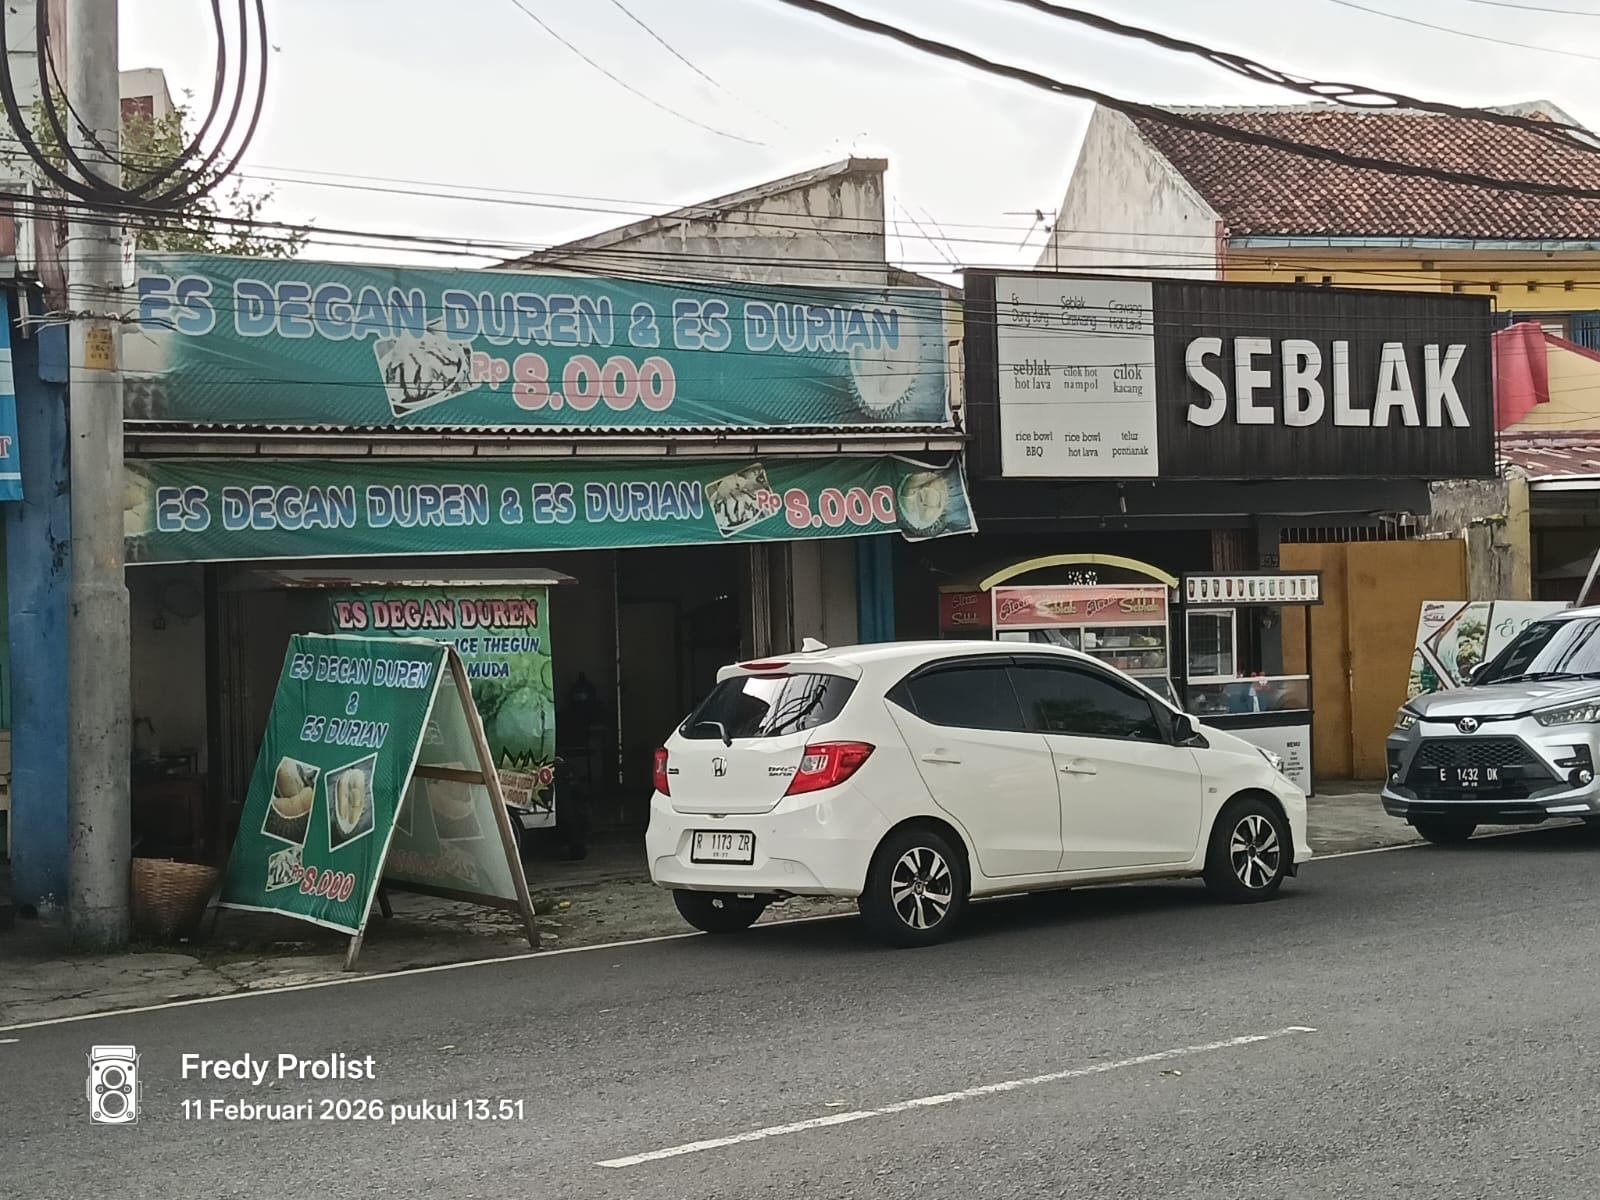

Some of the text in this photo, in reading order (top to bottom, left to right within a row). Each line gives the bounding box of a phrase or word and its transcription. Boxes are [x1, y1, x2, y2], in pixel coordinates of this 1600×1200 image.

[137, 277, 900, 353] ES DEGAN DUREN & ES DURIAN
[1013, 359, 1051, 376] seblak
[1062, 364, 1098, 377] cilok hot
[1113, 363, 1143, 380] cilok
[470, 351, 676, 412] Rp 8.000
[1015, 377, 1051, 390] hot lava
[1064, 379, 1098, 393] nampol
[1113, 381, 1143, 397] kacang
[1184, 336, 1470, 428] SEBLAK
[1015, 431, 1053, 441] rice bowl
[1064, 432, 1102, 442] rice bowl
[1026, 446, 1044, 458] BBQ
[1068, 447, 1099, 457] hot lava
[156, 480, 703, 532] ES DEGAN DUREN & ES DURIAN
[756, 485, 897, 530] Rp 8.000
[336, 598, 538, 630] ES DEGAN DUREN
[483, 637, 539, 653] THEGUN
[289, 653, 315, 680] ES
[315, 655, 371, 686] DEGAN
[372, 660, 433, 691] DUREN
[467, 662, 509, 678] MUDA
[345, 691, 359, 715] &
[300, 715, 389, 749] ES DURIAN
[1440, 768, 1447, 781] E
[1457, 768, 1479, 781] 1432
[697, 834, 750, 851] R 1173 ZR
[300, 866, 355, 902] 8.000
